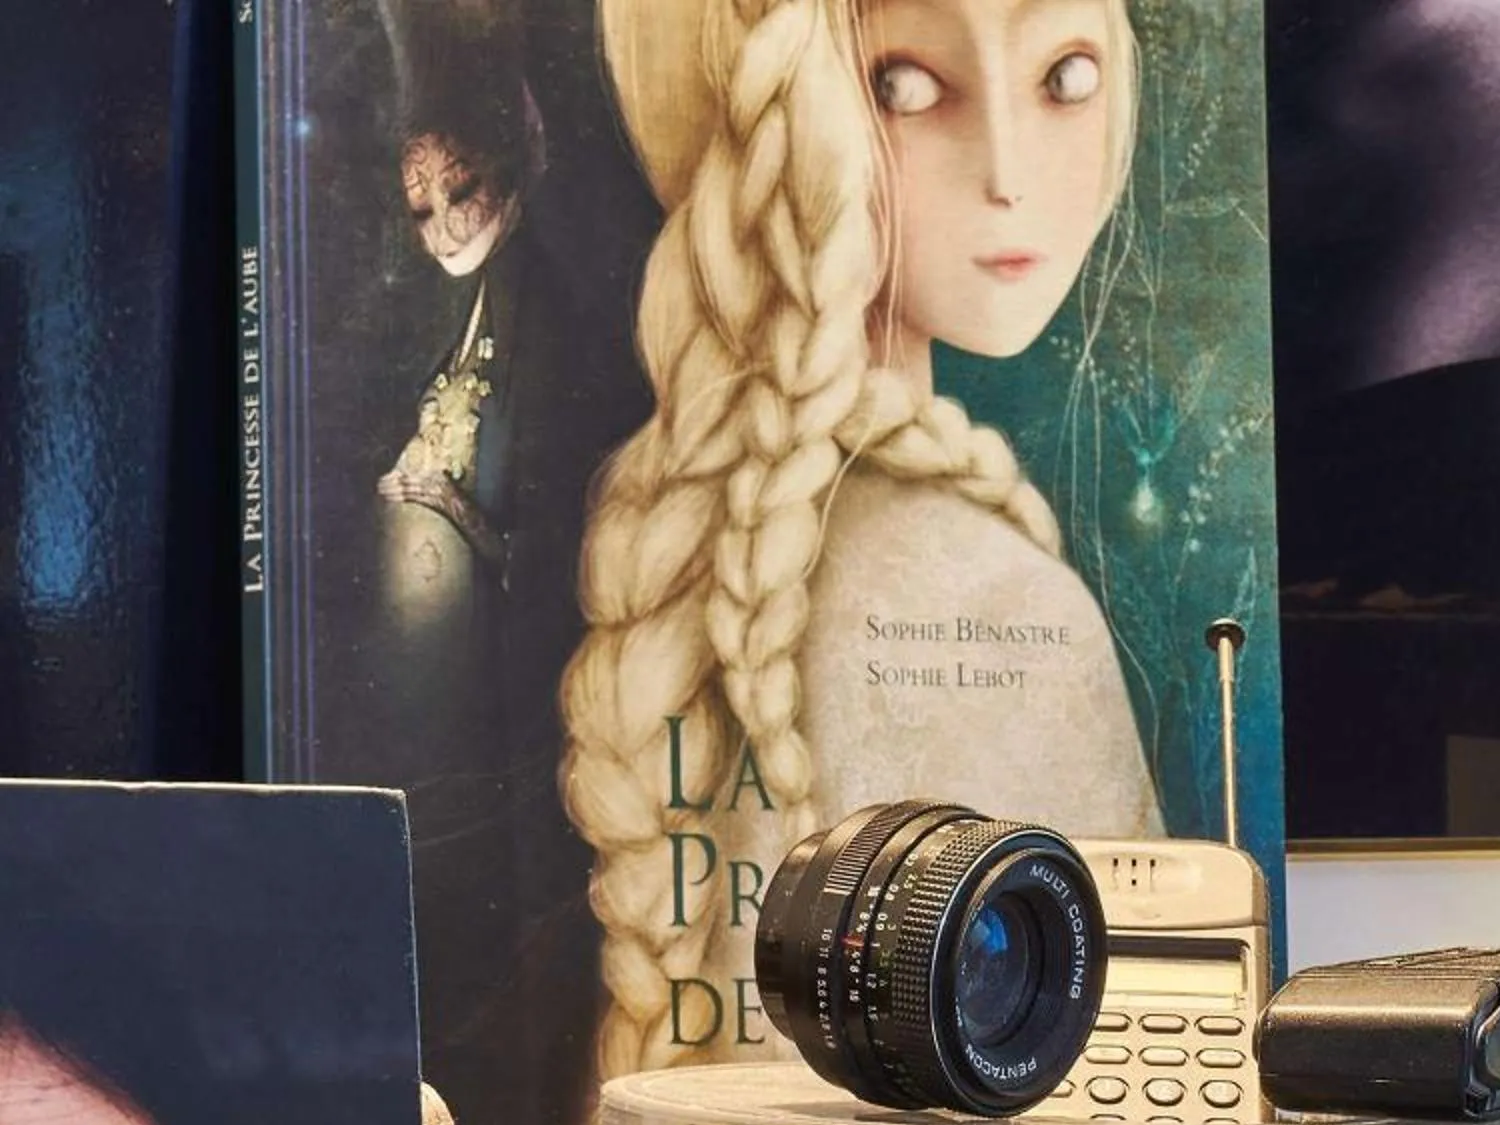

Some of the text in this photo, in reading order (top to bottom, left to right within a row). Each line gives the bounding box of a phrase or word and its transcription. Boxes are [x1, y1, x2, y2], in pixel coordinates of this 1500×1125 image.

[240, 246, 265, 592] LA PRINCESSE DE L'AUBE
[866, 614, 947, 642] SOPHIE
[866, 660, 1027, 689] SOPHIE LEBOT
[663, 715, 775, 811] LA
[1029, 863, 1086, 1000] MULTI COATING
[669, 977, 767, 1045] DE
[965, 1043, 1037, 1080] PENTACON
